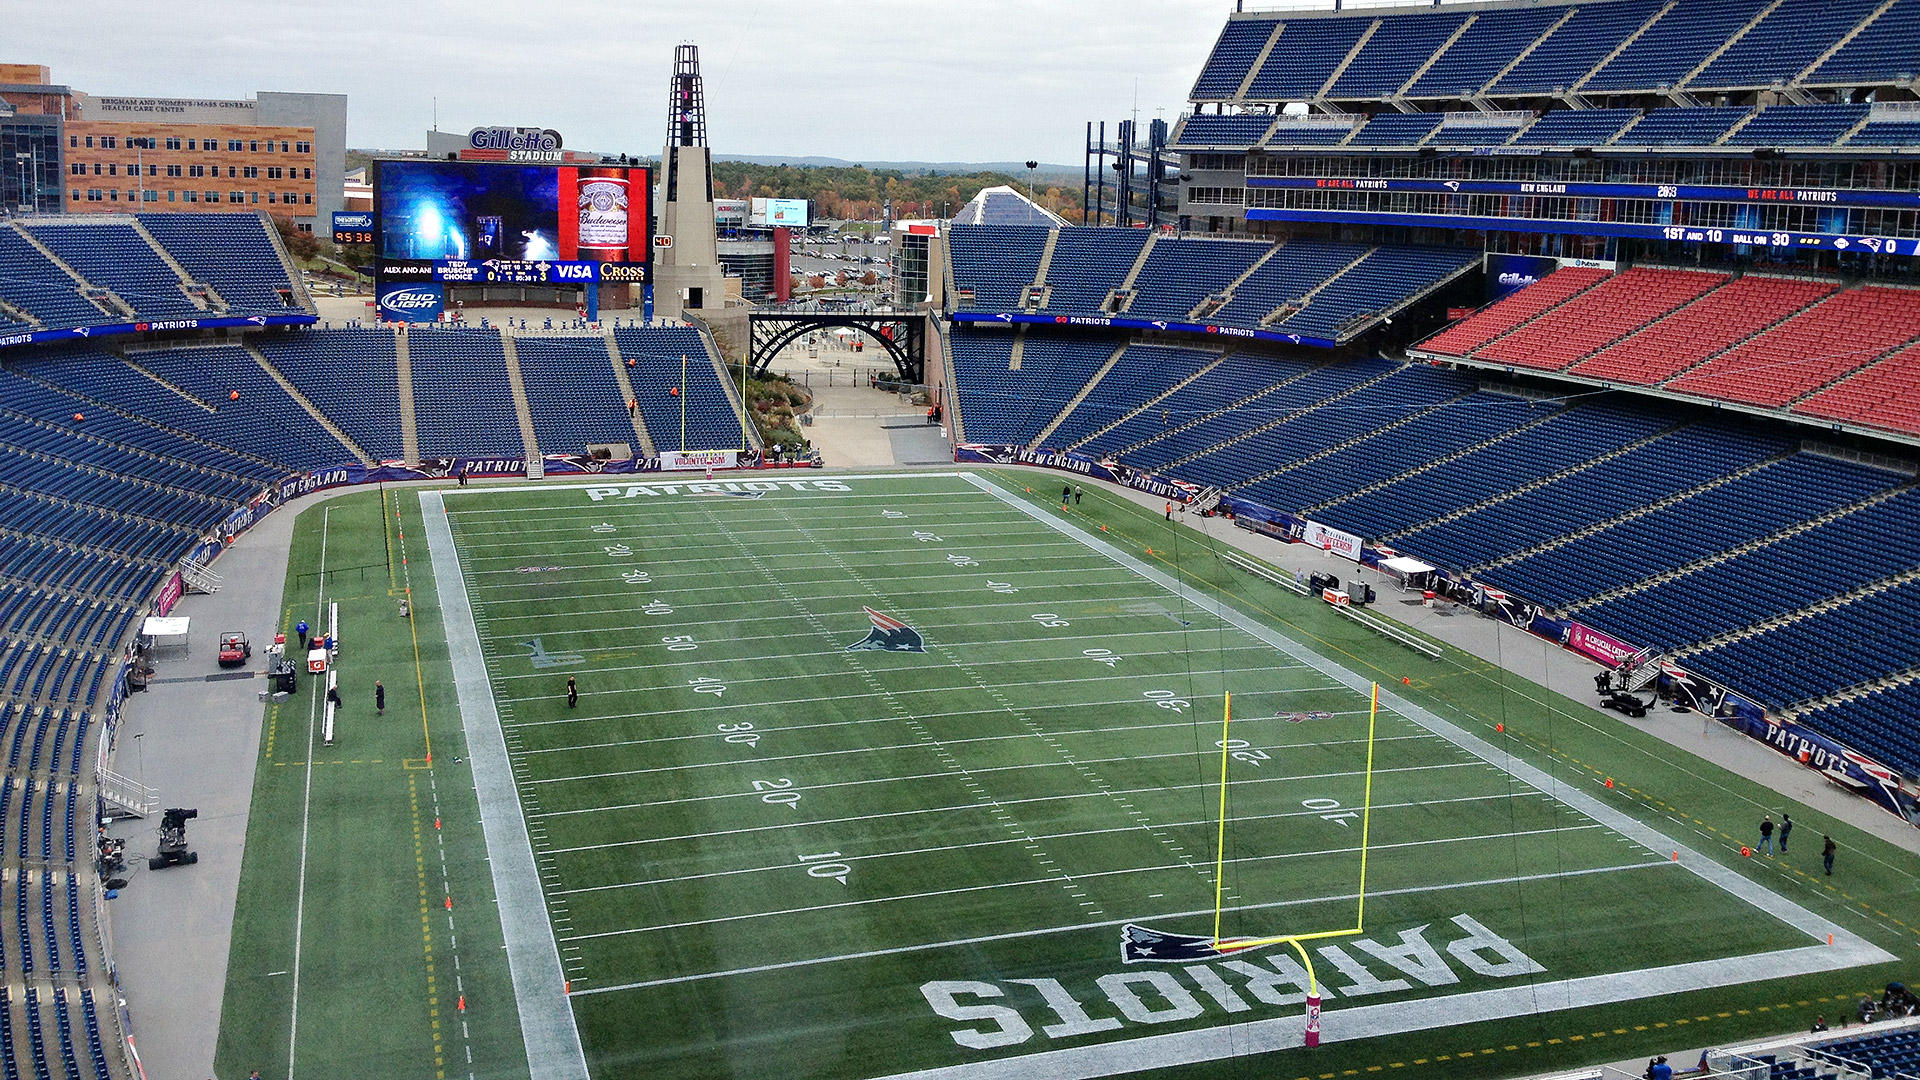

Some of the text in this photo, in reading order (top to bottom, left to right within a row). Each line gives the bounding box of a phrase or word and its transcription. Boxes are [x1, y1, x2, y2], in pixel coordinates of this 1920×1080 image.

[471, 129, 554, 150] Gillette
[510, 150, 563, 161] STADIUM
[1537, 184, 1566, 193] ENGLAND
[1748, 190, 1837, 201] WE ARE ALL PATRIOTS
[580, 212, 626, 225] Budweiser
[655, 237, 671, 246] 40
[1663, 228, 1685, 239] 1ST
[1706, 230, 1722, 242] 10
[1733, 235, 1752, 244] BALL
[1754, 236, 1767, 244] ON
[1772, 234, 1789, 246] 30
[1885, 240, 1896, 253] 0
[487, 271, 495, 280] 0
[540, 272, 547, 281] 3
[556, 265, 592, 278] VISA
[135, 320, 198, 332] GO PATRIOTS
[1055, 316, 1111, 326] GO PATRIOTS
[1219, 328, 1254, 338] PATRIOTS
[1019, 451, 1091, 473] NEW ENGLAND
[283, 471, 347, 498] NEW ENGLAND
[585, 480, 853, 501] PATRIOTS
[1134, 477, 1179, 498] PATRIOTS
[604, 545, 633, 556] 20
[947, 556, 980, 566] 30
[622, 572, 652, 584] 30
[1031, 614, 1070, 628] 50
[661, 635, 698, 651] 50
[1590, 636, 1611, 651] CRUCIAL
[1083, 649, 1123, 663] 40
[688, 677, 726, 693] 40
[1143, 690, 1191, 710] 30
[717, 722, 760, 743] 30
[1215, 739, 1272, 762] 20
[1766, 724, 1848, 774] PATRIOTS
[752, 778, 801, 804] 20
[1302, 799, 1360, 822] 10
[798, 851, 851, 878] 10
[920, 912, 1548, 1050] PATRIOTS
